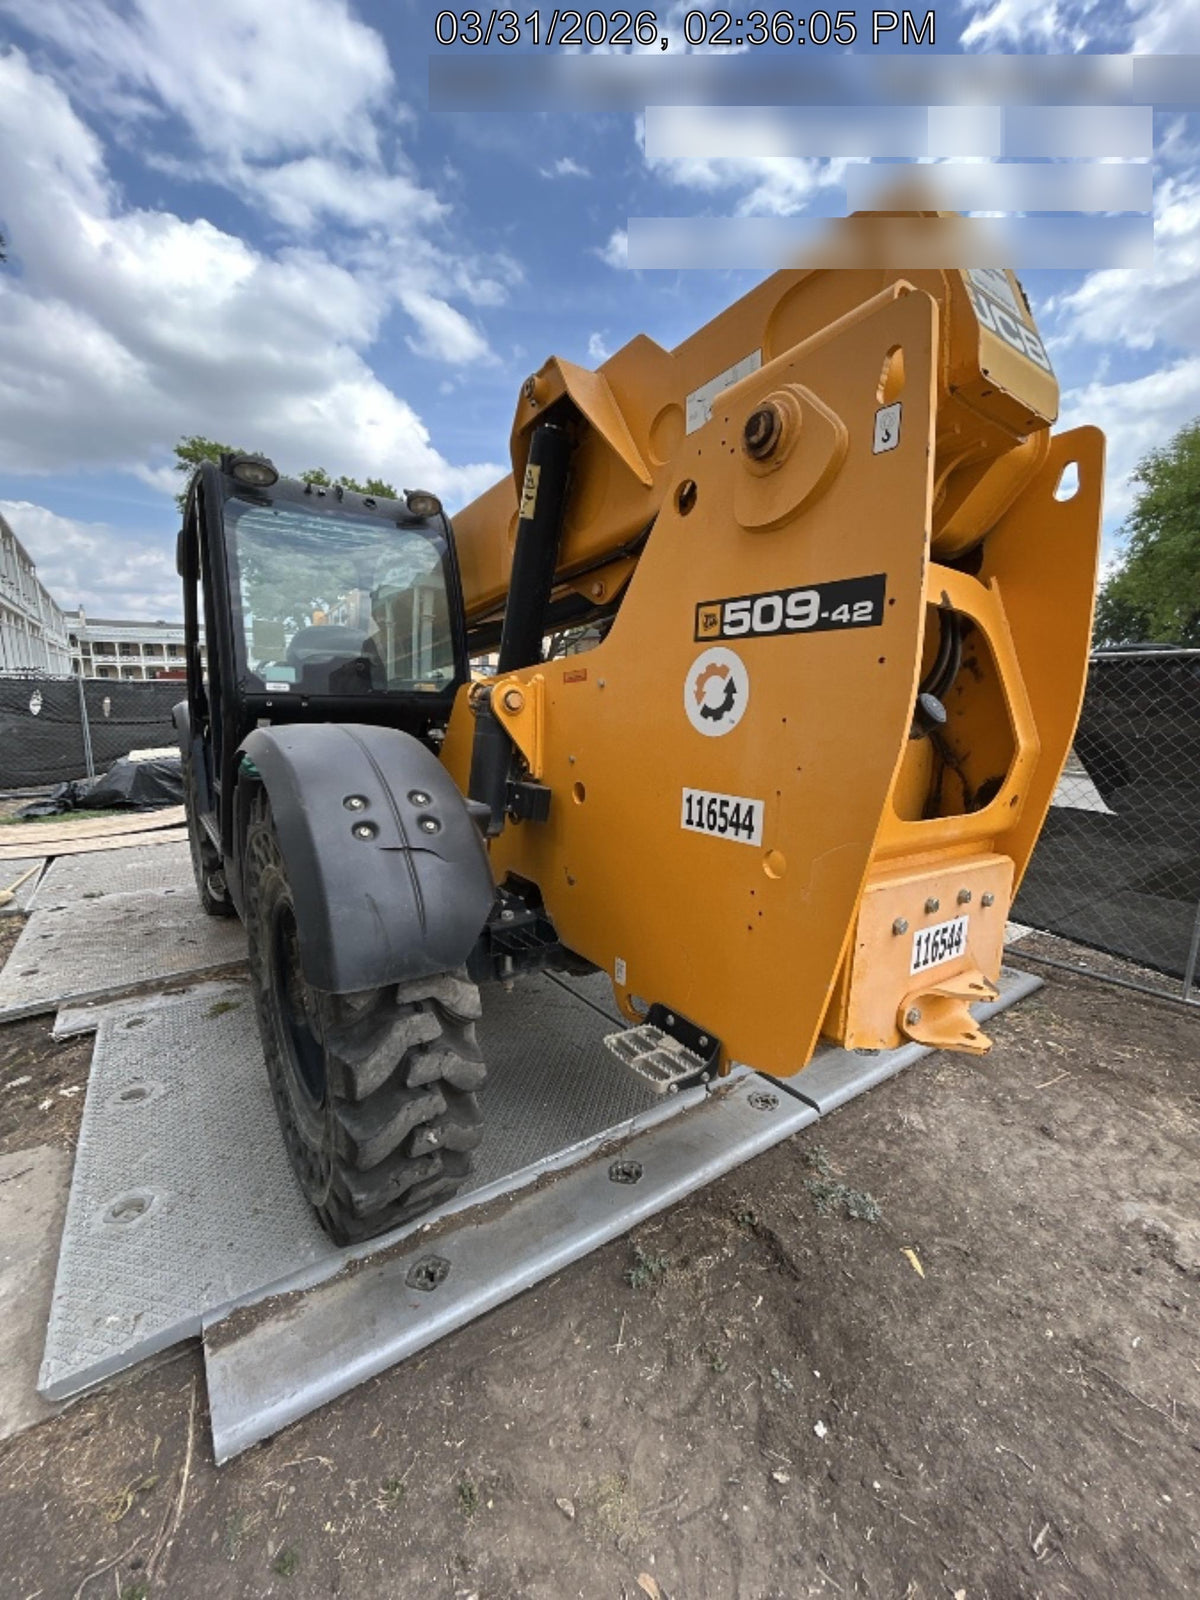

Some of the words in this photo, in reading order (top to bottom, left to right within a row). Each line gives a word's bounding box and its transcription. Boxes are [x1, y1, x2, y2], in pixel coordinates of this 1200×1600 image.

[972, 292, 1052, 372] JCB
[722, 589, 874, 636] 509-42
[685, 793, 755, 840] 116544
[912, 921, 964, 970] 116544
